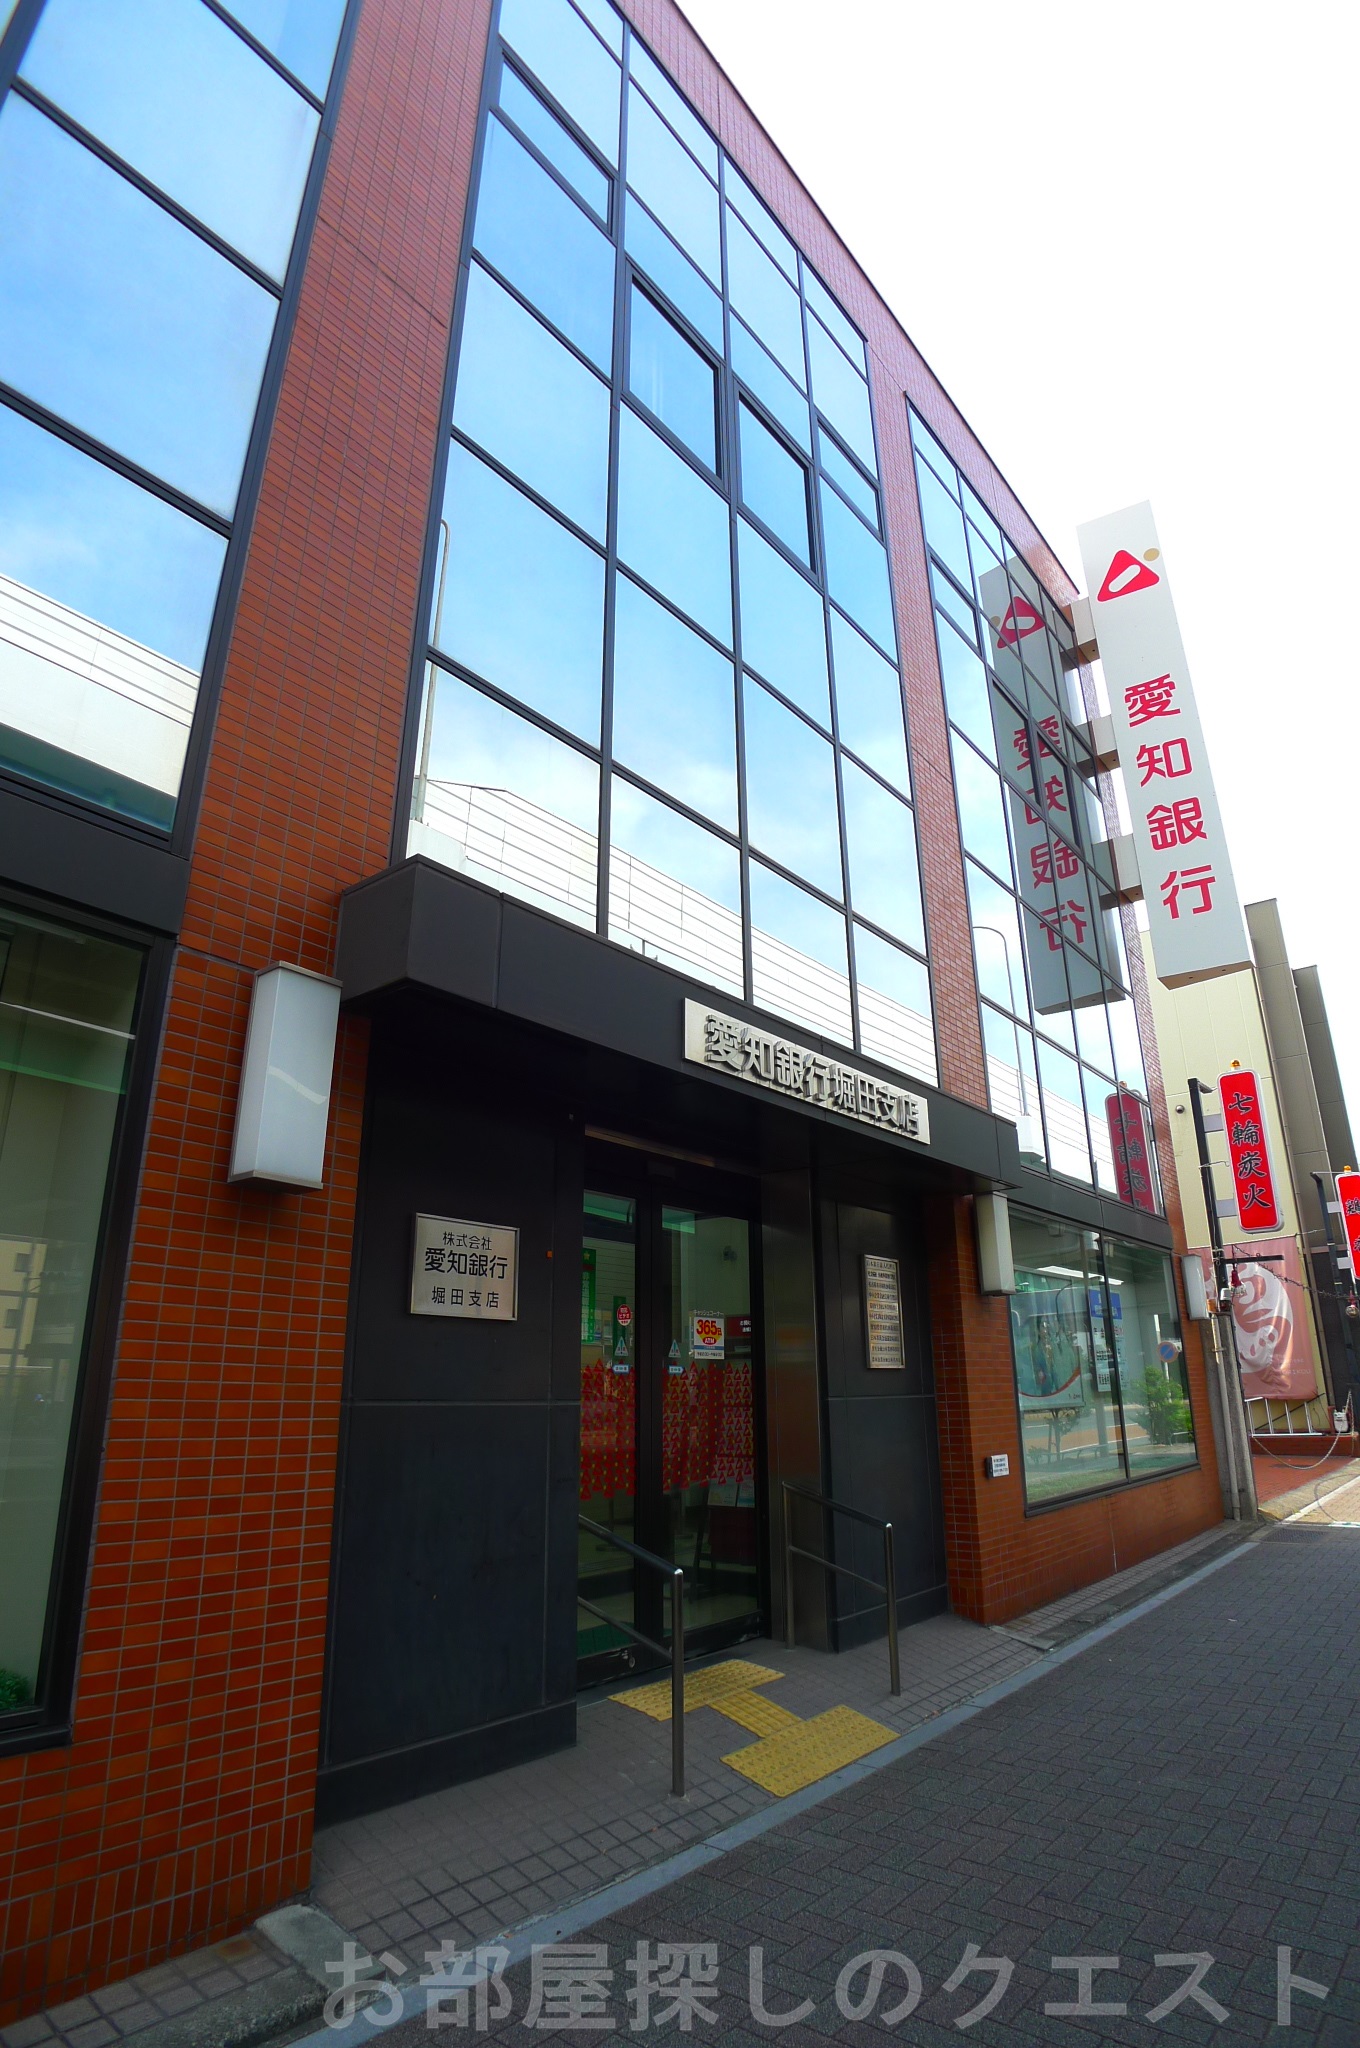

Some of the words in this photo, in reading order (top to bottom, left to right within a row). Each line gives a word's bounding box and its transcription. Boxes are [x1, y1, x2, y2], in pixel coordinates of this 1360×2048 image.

[1124, 673, 1217, 920] 愛知銀行
[704, 1014, 919, 1136] 愛知銀行堀田支店
[1228, 1091, 1272, 1211] 七輪炭火
[425, 1247, 508, 1279] 愛知銀行
[443, 1231, 492, 1251] 株式会社
[432, 1286, 499, 1308] 堀田支店
